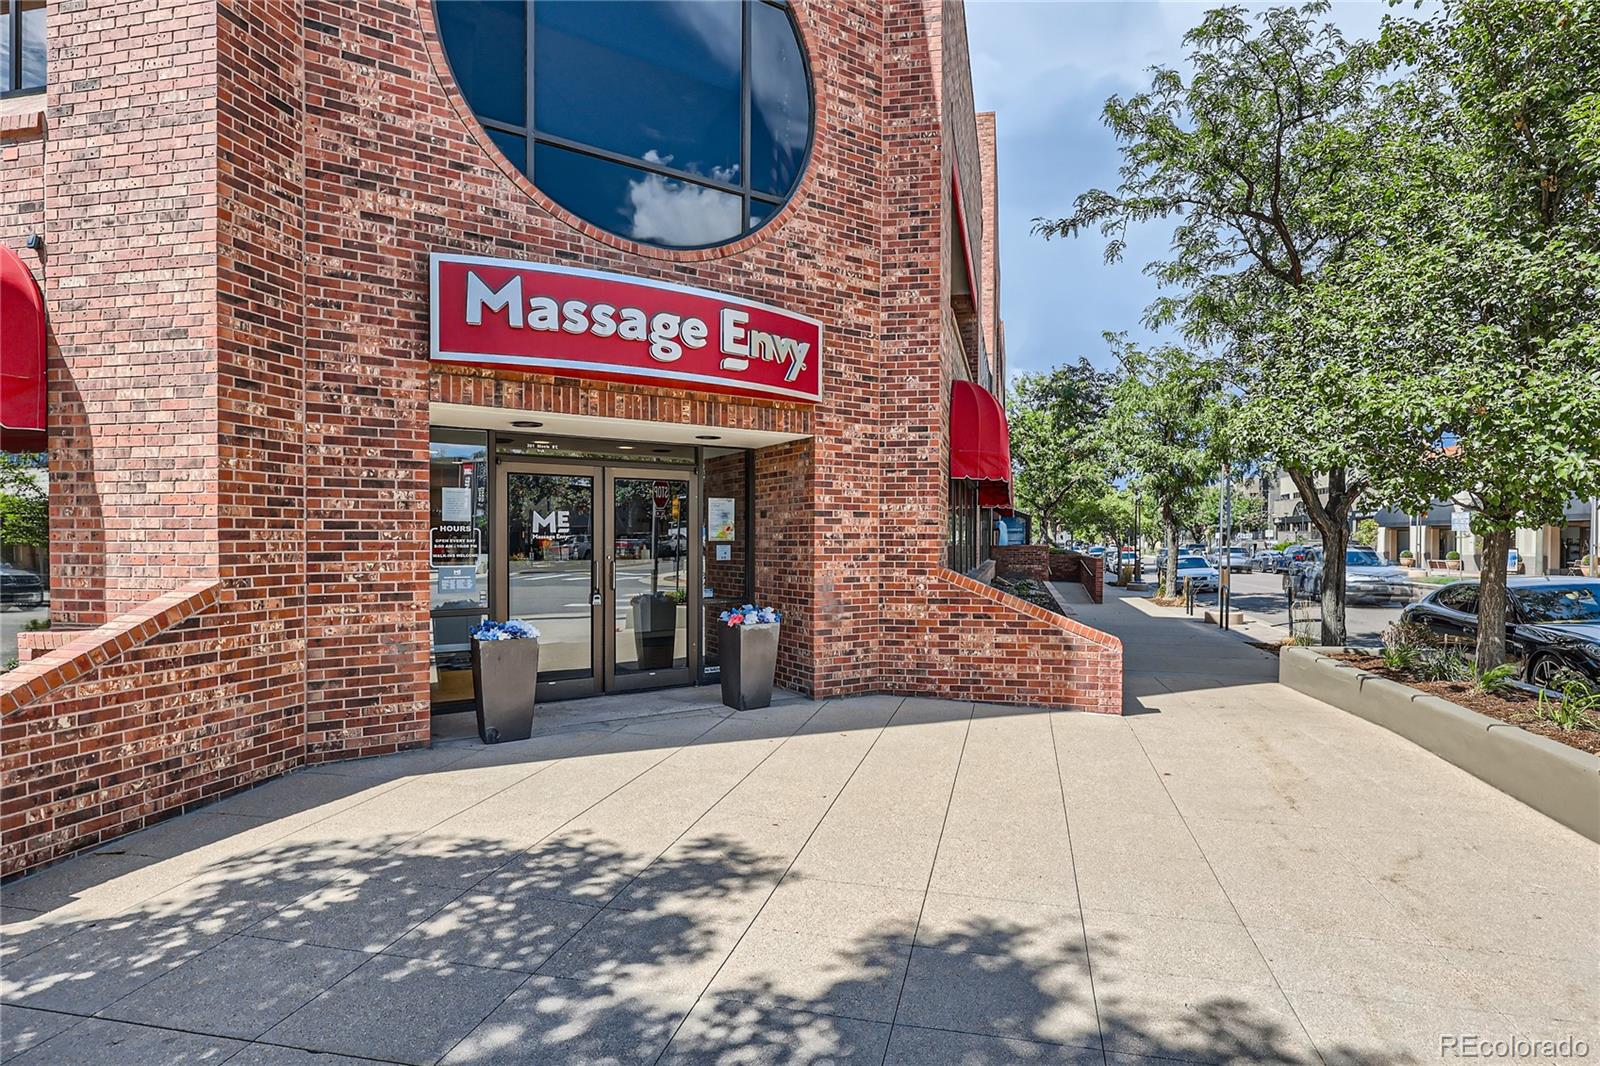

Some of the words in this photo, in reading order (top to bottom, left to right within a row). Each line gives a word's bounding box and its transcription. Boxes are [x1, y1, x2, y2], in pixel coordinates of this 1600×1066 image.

[466, 270, 708, 362] Massage
[719, 308, 810, 382] Envy
[532, 510, 570, 533] ME
